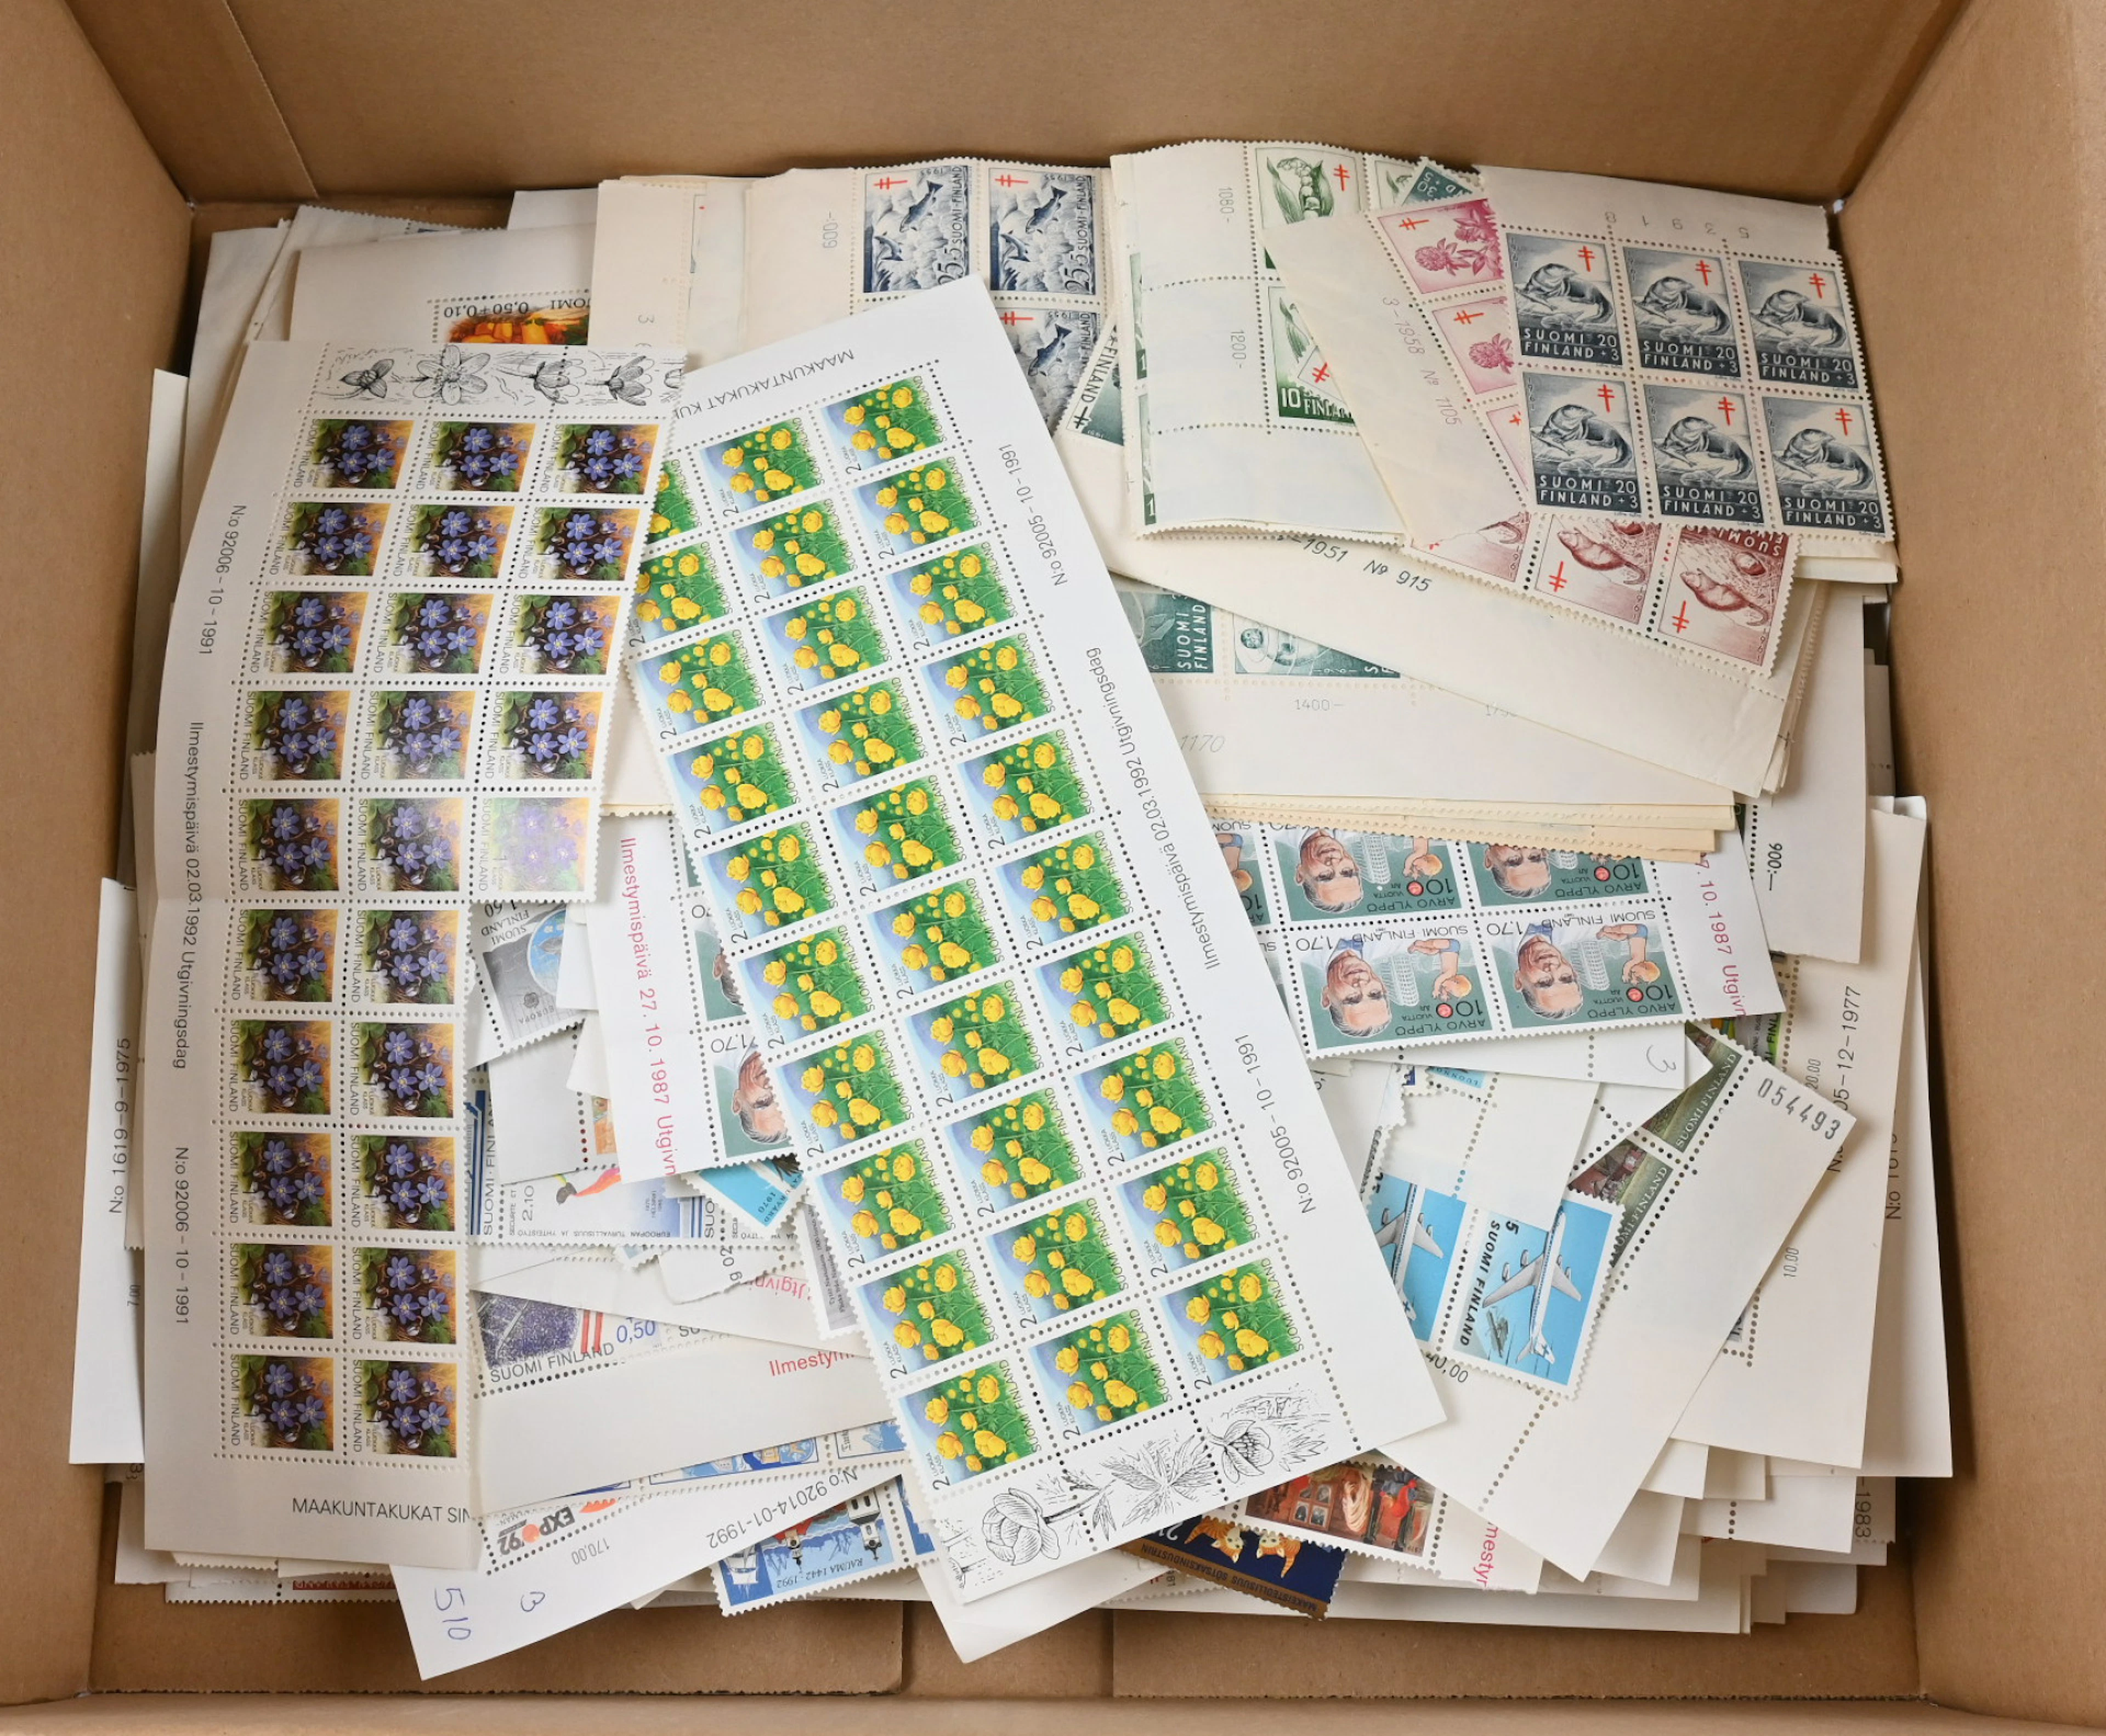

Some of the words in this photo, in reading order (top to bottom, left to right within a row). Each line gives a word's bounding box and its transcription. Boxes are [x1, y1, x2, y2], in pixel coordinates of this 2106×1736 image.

[1524, 329, 1583, 344] SUOMI
[1598, 334, 1617, 348] 20
[1525, 341, 1594, 359] FINLAND
[1643, 341, 1701, 356] SUOMI
[1716, 347, 1735, 359] 20
[707, 349, 854, 410] MAAKUNTAKUKAT
[1644, 354, 1713, 371] FINLAND
[1761, 352, 1820, 368] SUOMI
[1832, 359, 1852, 372] 20
[1762, 367, 1830, 383] FINLAND
[1280, 387, 1301, 408] 10
[305, 419, 319, 448] SUOMI
[294, 451, 312, 488] FINLAND
[1539, 475, 1602, 491] SUOMI
[1616, 480, 1636, 494] 20
[1540, 489, 1612, 506] FINLAND
[1663, 486, 1724, 502] SUOMI
[1738, 491, 1758, 504] 20
[1664, 500, 1735, 517] FINLAND
[1784, 497, 1845, 512] SUOMI
[1859, 501, 1878, 515] 20
[528, 507, 543, 538] SUOMI
[1786, 510, 1856, 526] FINLAND
[519, 541, 535, 579] FINLAND
[1396, 570, 1432, 592] 915
[383, 593, 398, 627] SUOMI
[373, 629, 389, 673] FINLAND
[1177, 612, 1192, 670] SUOMI
[1194, 603, 1209, 670] FINLAND
[245, 691, 256, 729] SUOMI
[1086, 647, 1135, 756] Utgivningsdag
[240, 733, 252, 780] FINLAND
[358, 798, 367, 838] SUOMI
[480, 798, 492, 837] SUOMI
[358, 842, 367, 891] FINLAND
[479, 841, 489, 891] FINLAND
[1418, 895, 1456, 909] ARVO
[1604, 881, 1643, 894] ARVO
[1423, 925, 1468, 937] SUOMI
[1541, 914, 1604, 930] FINLAND
[1610, 909, 1656, 922] SUOMI
[1708, 912, 1733, 955] 1987
[1352, 929, 1416, 943] FINLAND
[172, 950, 195, 1069] Utgivningsdag
[1447, 1018, 1486, 1031] ARVO
[1637, 1001, 1677, 1014] ARVO
[230, 1019, 240, 1061] SUOMI
[229, 1064, 239, 1112] FINLAND
[650, 1059, 670, 1104] 1987
[1757, 1077, 1842, 1141] 054493
[1480, 1220, 1501, 1273] SUOMI
[1505, 1221, 1519, 1235] 5
[352, 1247, 361, 1287] SUOMI
[352, 1290, 362, 1340] FINLAND
[1460, 1277, 1486, 1346] FINLAND
[490, 1359, 542, 1383] SUOMI
[547, 1342, 615, 1369] FINLAND
[616, 1319, 656, 1344] 0,50
[230, 1354, 240, 1393] SUOMI
[353, 1359, 363, 1400] SUOMI
[890, 1365, 908, 1380] 2
[230, 1395, 240, 1446] FINLAND
[352, 1403, 362, 1453] FINLAND
[292, 1497, 442, 1522] MAAKUNTAKUKAT
[706, 1484, 828, 1550] 92014-01-1992
